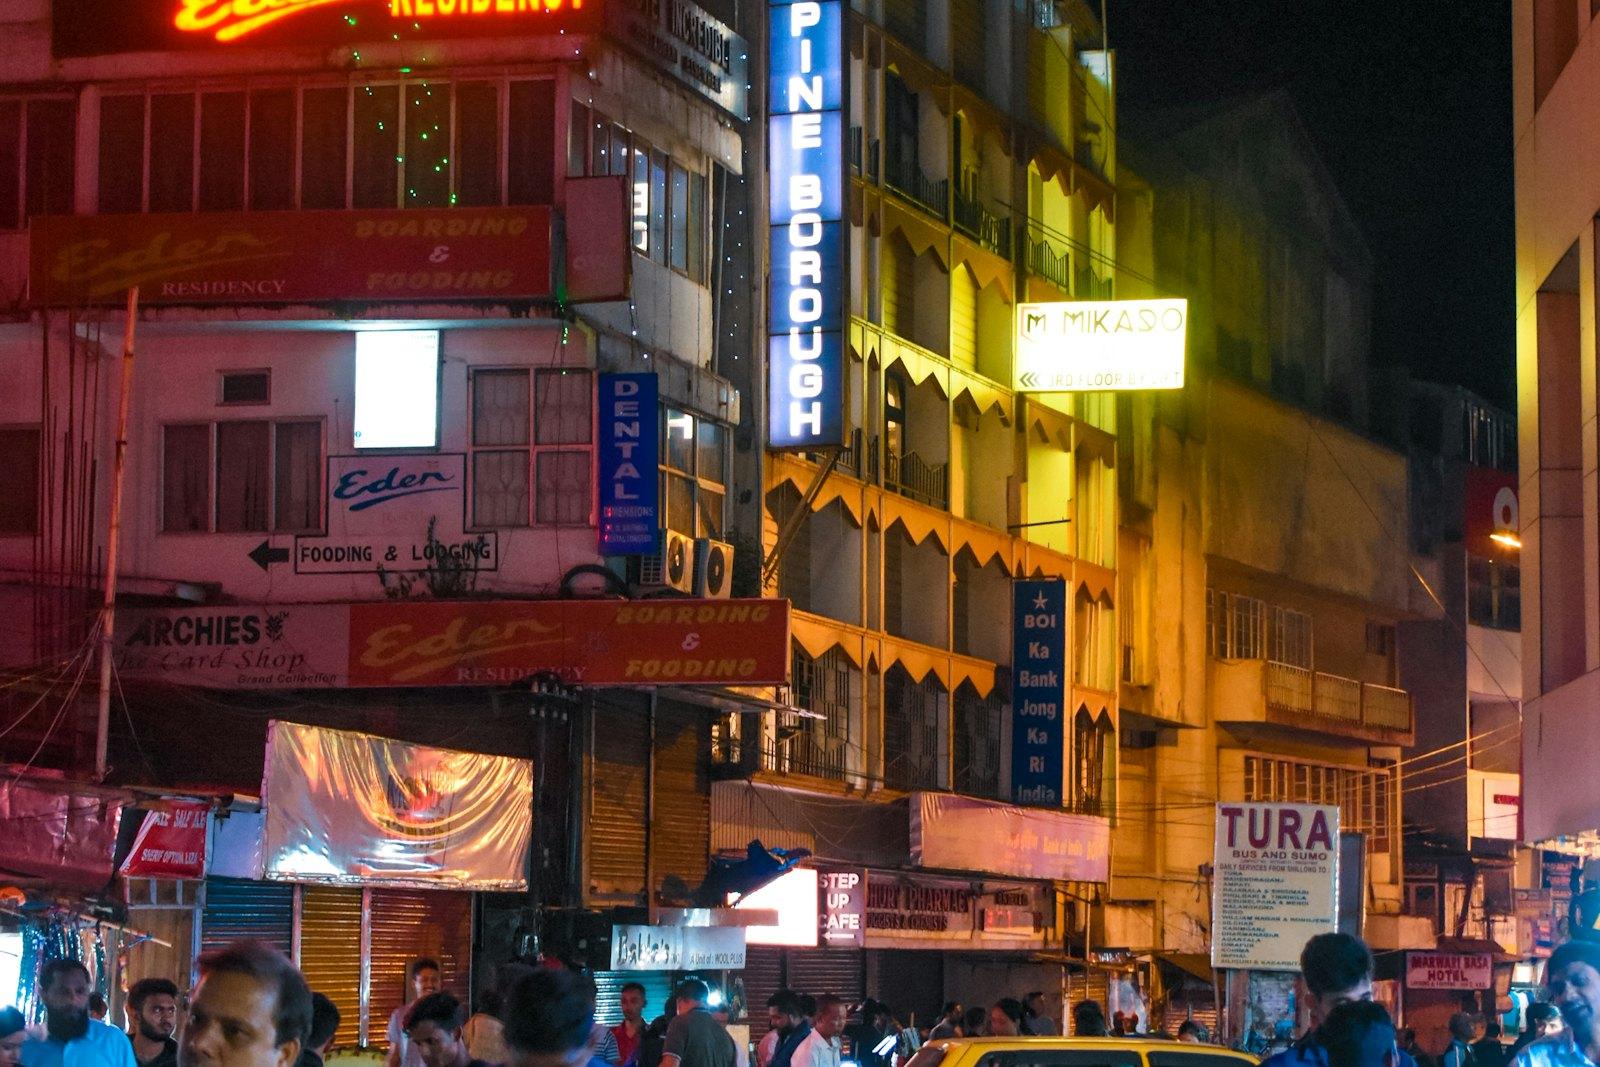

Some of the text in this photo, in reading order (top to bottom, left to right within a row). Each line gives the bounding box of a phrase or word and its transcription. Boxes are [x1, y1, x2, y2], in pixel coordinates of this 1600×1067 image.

[355, 216, 528, 238] BOARDING
[788, 2, 823, 437] PINE BOROUGH
[429, 245, 450, 264] &
[162, 280, 286, 295] RESIDENCY
[366, 271, 514, 290] FOODING
[613, 381, 641, 499] DENTAL
[333, 467, 456, 504] Eden
[301, 546, 372, 562] FOODING
[385, 546, 397, 561] &
[616, 604, 770, 625] BOARDING
[1024, 614, 1056, 628] BOI
[125, 616, 260, 646] ARCHIES
[360, 617, 565, 670] Eden
[682, 632, 699, 650] &
[1028, 642, 1049, 659] Ka
[235, 647, 305, 673] Shop
[625, 659, 757, 678] FOODING
[238, 673, 337, 684] Grand Collection
[1019, 670, 1058, 687] Bank
[1020, 700, 1057, 720] Jong
[1027, 728, 1048, 744] Ka
[1029, 756, 1045, 773] Ri
[1018, 785, 1055, 801] India
[1221, 808, 1333, 850] TURA
[1232, 850, 1327, 861] BUS AND SUMO
[819, 873, 859, 889] STEP
[827, 893, 849, 909] UP
[819, 914, 860, 929] CAFE
[715, 953, 730, 964] WOOL
[731, 953, 743, 964] PLUS
[1427, 969, 1468, 981] HOTEL
